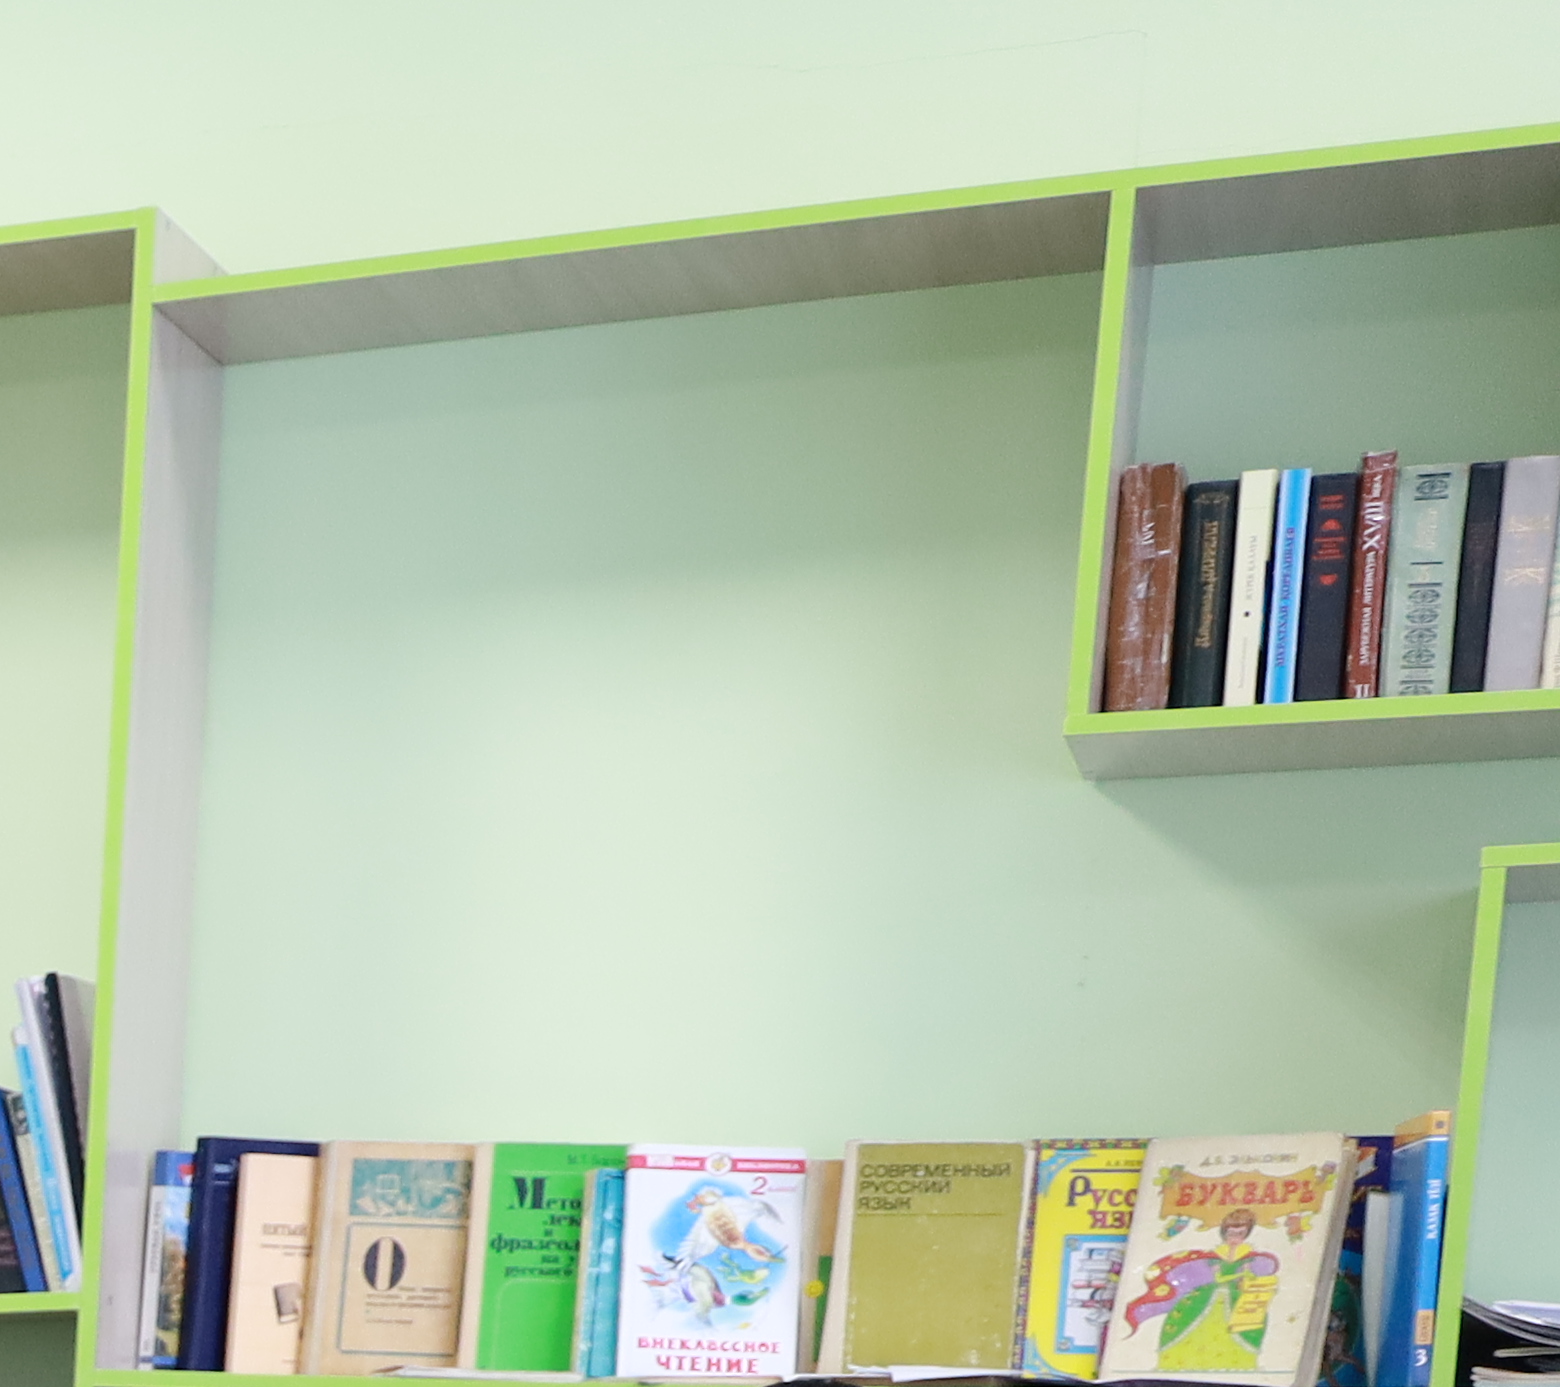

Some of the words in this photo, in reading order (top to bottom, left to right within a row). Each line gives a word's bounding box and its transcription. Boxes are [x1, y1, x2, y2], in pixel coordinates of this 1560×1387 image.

[1362, 501, 1387, 551] XVIII
[1363, 550, 1378, 605] ЛИТЕРАТУРА
[1359, 606, 1373, 666] ЗАРУБЕЖНАЯ
[859, 1162, 1012, 1178] СОВРЕМЕННЫЙ
[751, 1176, 768, 1196] 2
[859, 1179, 952, 1195] РУССКИЙ
[1175, 1179, 1316, 1207] БУКВАРЬ
[857, 1196, 912, 1210] ЯЗЫК
[491, 1232, 581, 1254] фразеол
[637, 1336, 782, 1354] ВНЕКЛАССНОЕ
[655, 1354, 760, 1374] ЧТЕНИЕ
[1414, 1349, 1429, 1366] 3
